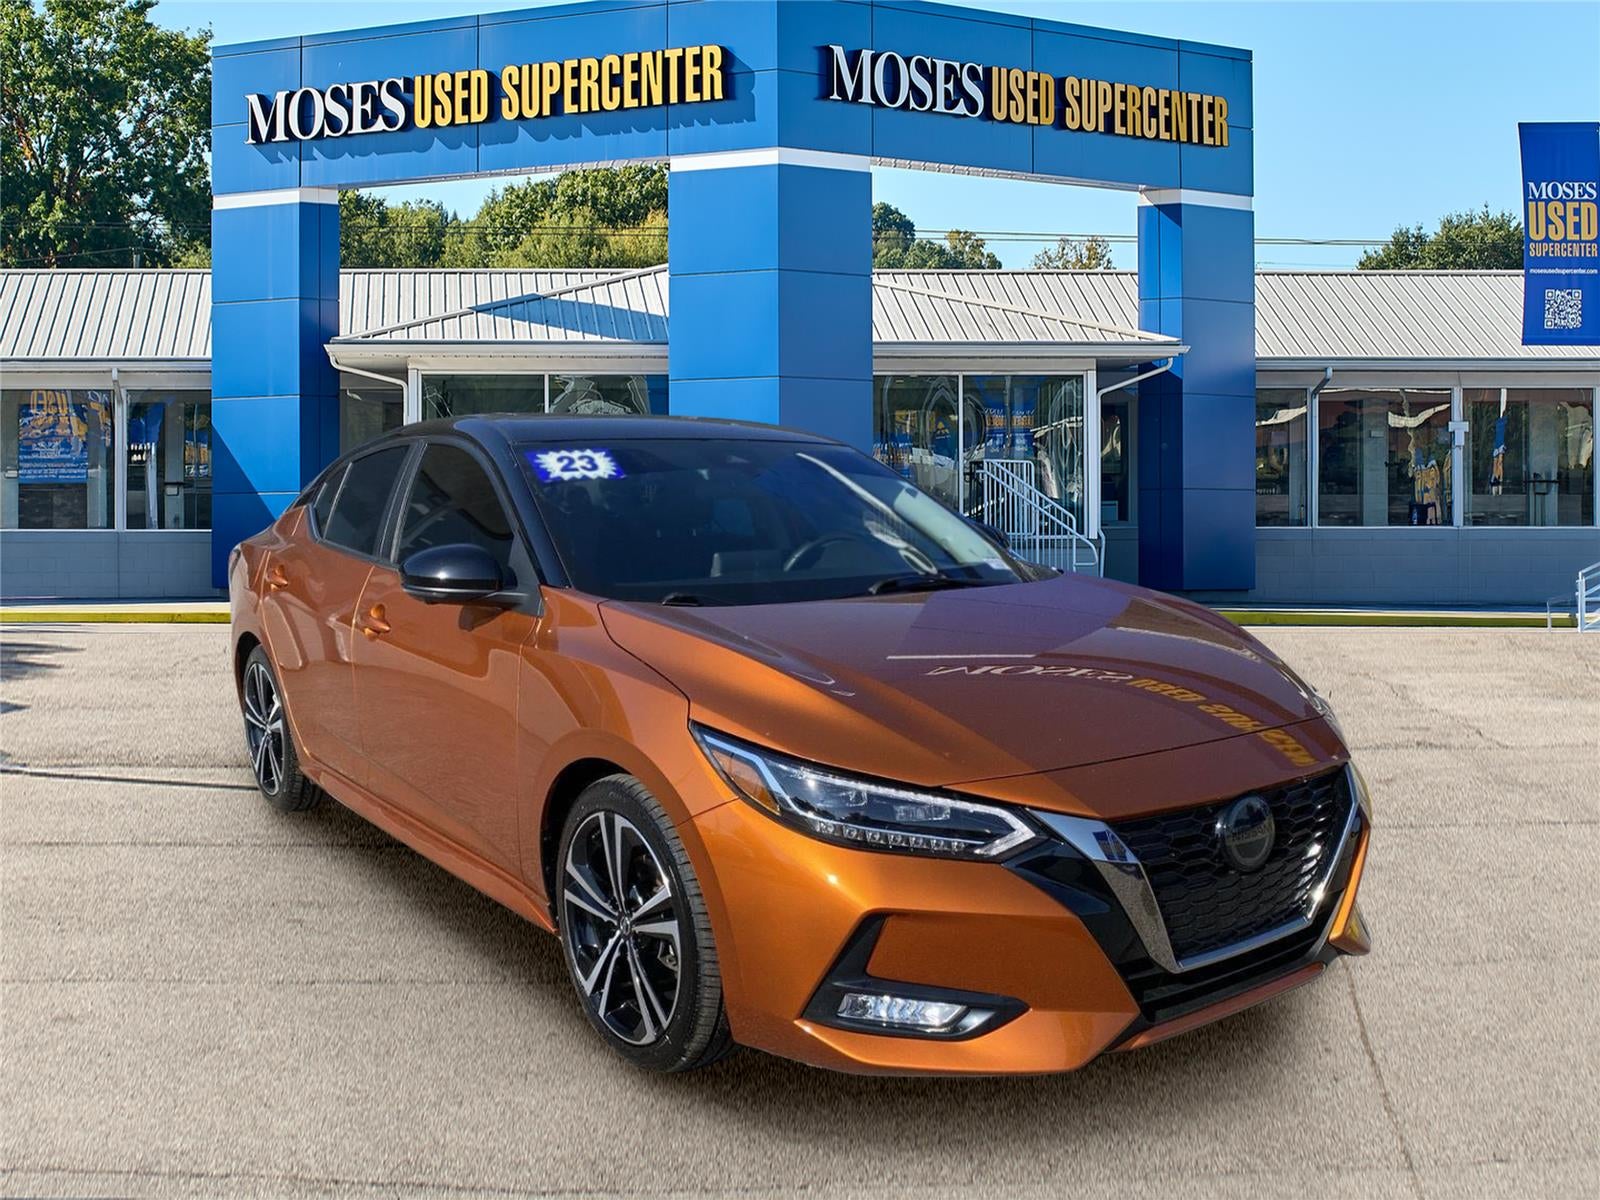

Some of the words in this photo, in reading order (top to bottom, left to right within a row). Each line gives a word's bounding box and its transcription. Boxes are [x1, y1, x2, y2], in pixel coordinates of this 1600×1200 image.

[244, 77, 408, 144] MOSES
[413, 70, 490, 129] USED
[500, 44, 725, 121] SUPERCENTER
[829, 44, 984, 118] MOSES
[991, 66, 1056, 126] USED
[1065, 76, 1230, 147] SUPERCENTER
[1527, 181, 1597, 200] MOSES
[1528, 201, 1598, 241] USED
[1529, 243, 1598, 257] SUPERCENTER
[556, 455, 599, 472] 23
